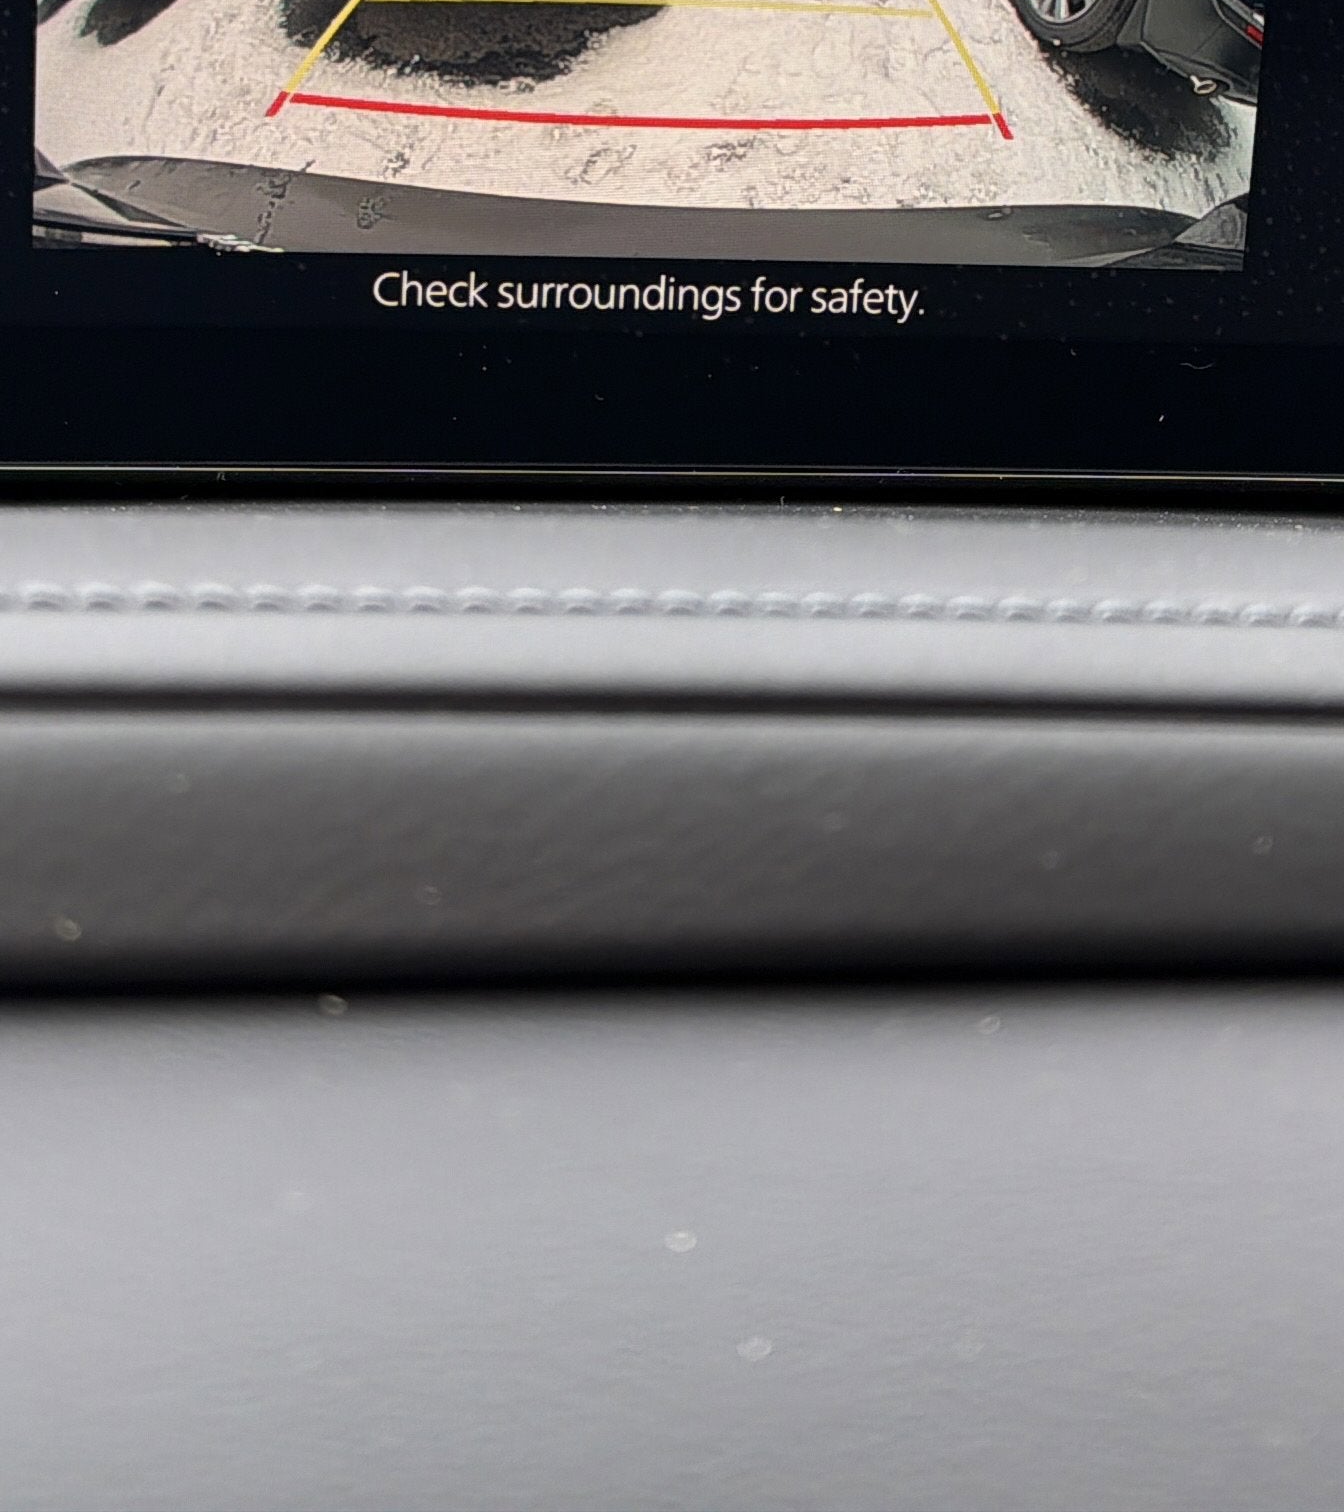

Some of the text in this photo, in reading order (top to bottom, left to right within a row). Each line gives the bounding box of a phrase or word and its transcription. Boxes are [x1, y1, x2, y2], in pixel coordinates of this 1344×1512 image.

[372, 269, 926, 324] Check surroundings for safety.
